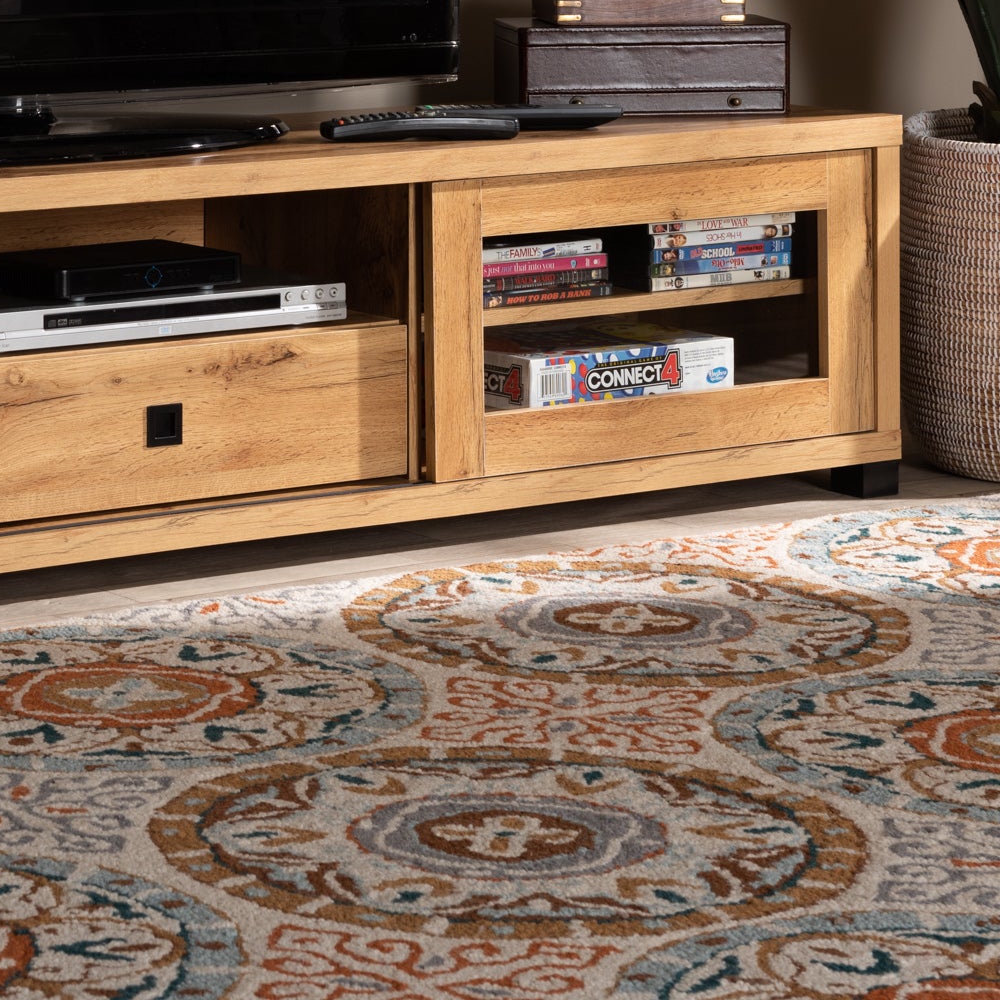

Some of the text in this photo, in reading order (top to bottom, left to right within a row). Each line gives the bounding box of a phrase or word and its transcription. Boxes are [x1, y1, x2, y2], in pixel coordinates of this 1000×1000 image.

[701, 220, 722, 230] LOVE
[730, 217, 749, 227] WAR
[706, 233, 726, 242] SHOES
[496, 251, 509, 260] THE
[509, 247, 538, 258] FAMILY
[702, 247, 735, 259] SCHOOL
[487, 265, 500, 277] just
[514, 263, 527, 272] that
[528, 262, 541, 271] into
[541, 262, 555, 272] you
[507, 296, 527, 304] HOW
[528, 294, 539, 302] TO
[541, 292, 559, 300] ROB
[560, 291, 567, 299] A
[567, 289, 592, 298] BANK
[588, 363, 662, 386] CONNECT
[661, 353, 679, 384] 4
